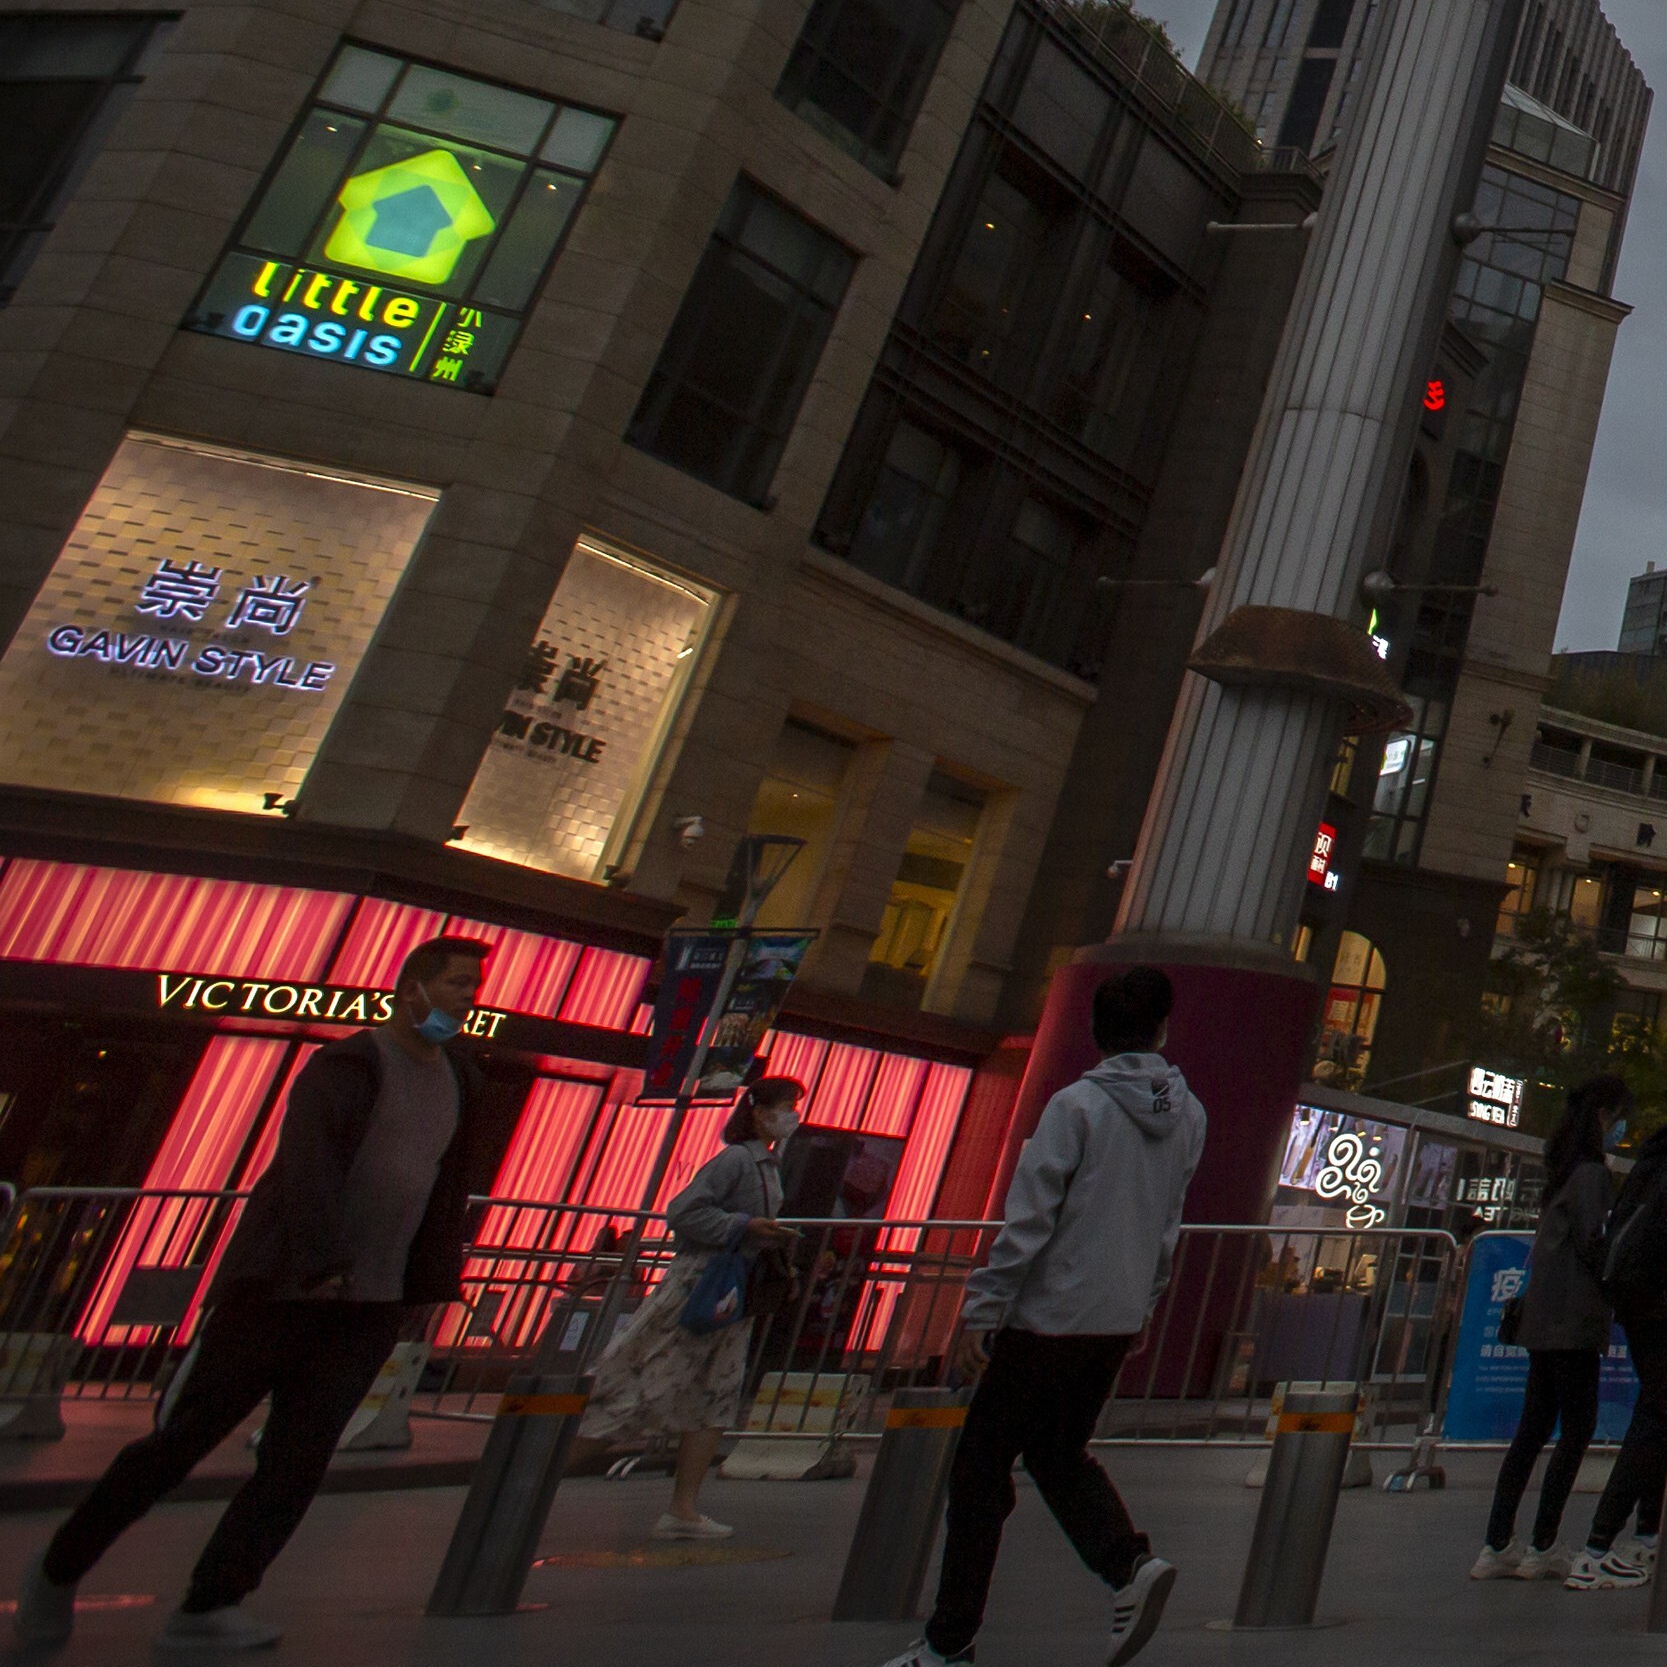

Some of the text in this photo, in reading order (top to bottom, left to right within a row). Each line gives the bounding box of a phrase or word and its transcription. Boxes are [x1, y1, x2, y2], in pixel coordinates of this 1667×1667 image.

[251, 260, 420, 329] little
[232, 303, 403, 367] oasis
[134, 558, 311, 635] 崇尚
[48, 625, 190, 670] GAVIN
[192, 645, 336, 691] STYLE
[529, 722, 607, 764] STYLE
[157, 974, 394, 1021] VICTORIA'S
